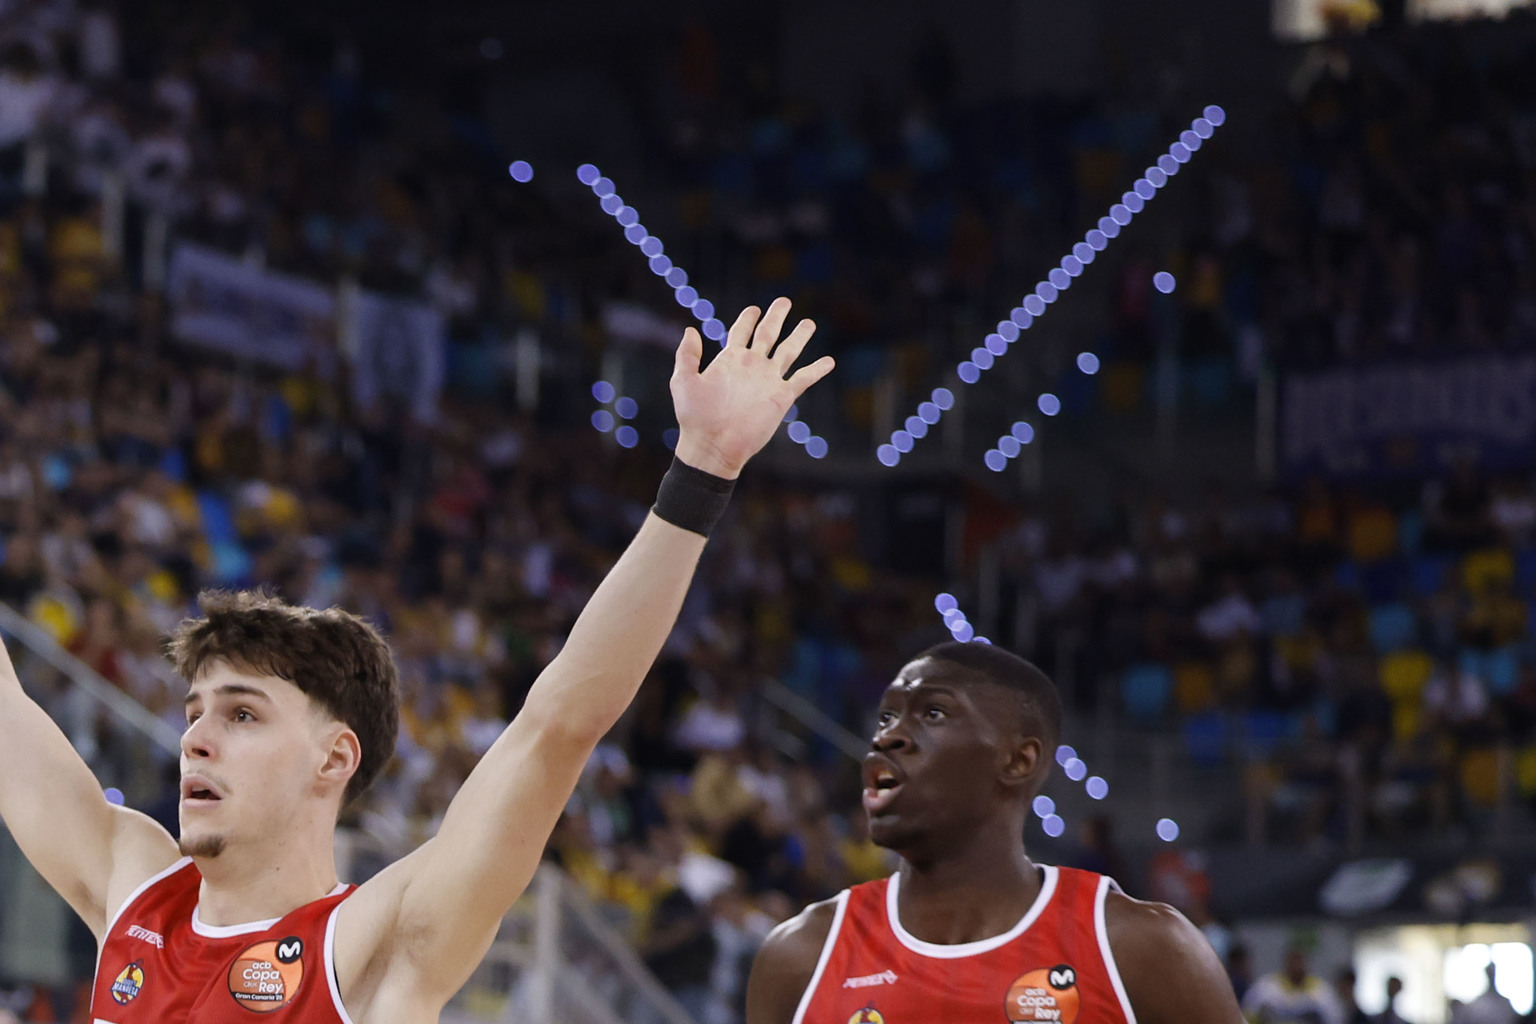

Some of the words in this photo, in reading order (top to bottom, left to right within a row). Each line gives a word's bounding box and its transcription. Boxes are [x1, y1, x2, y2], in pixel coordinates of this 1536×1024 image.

[252, 961, 272, 969] acb
[243, 968, 280, 981] Copa
[258, 981, 284, 994] Rey
[1017, 995, 1056, 1007] Copa
[1035, 1007, 1061, 1020] Rey
